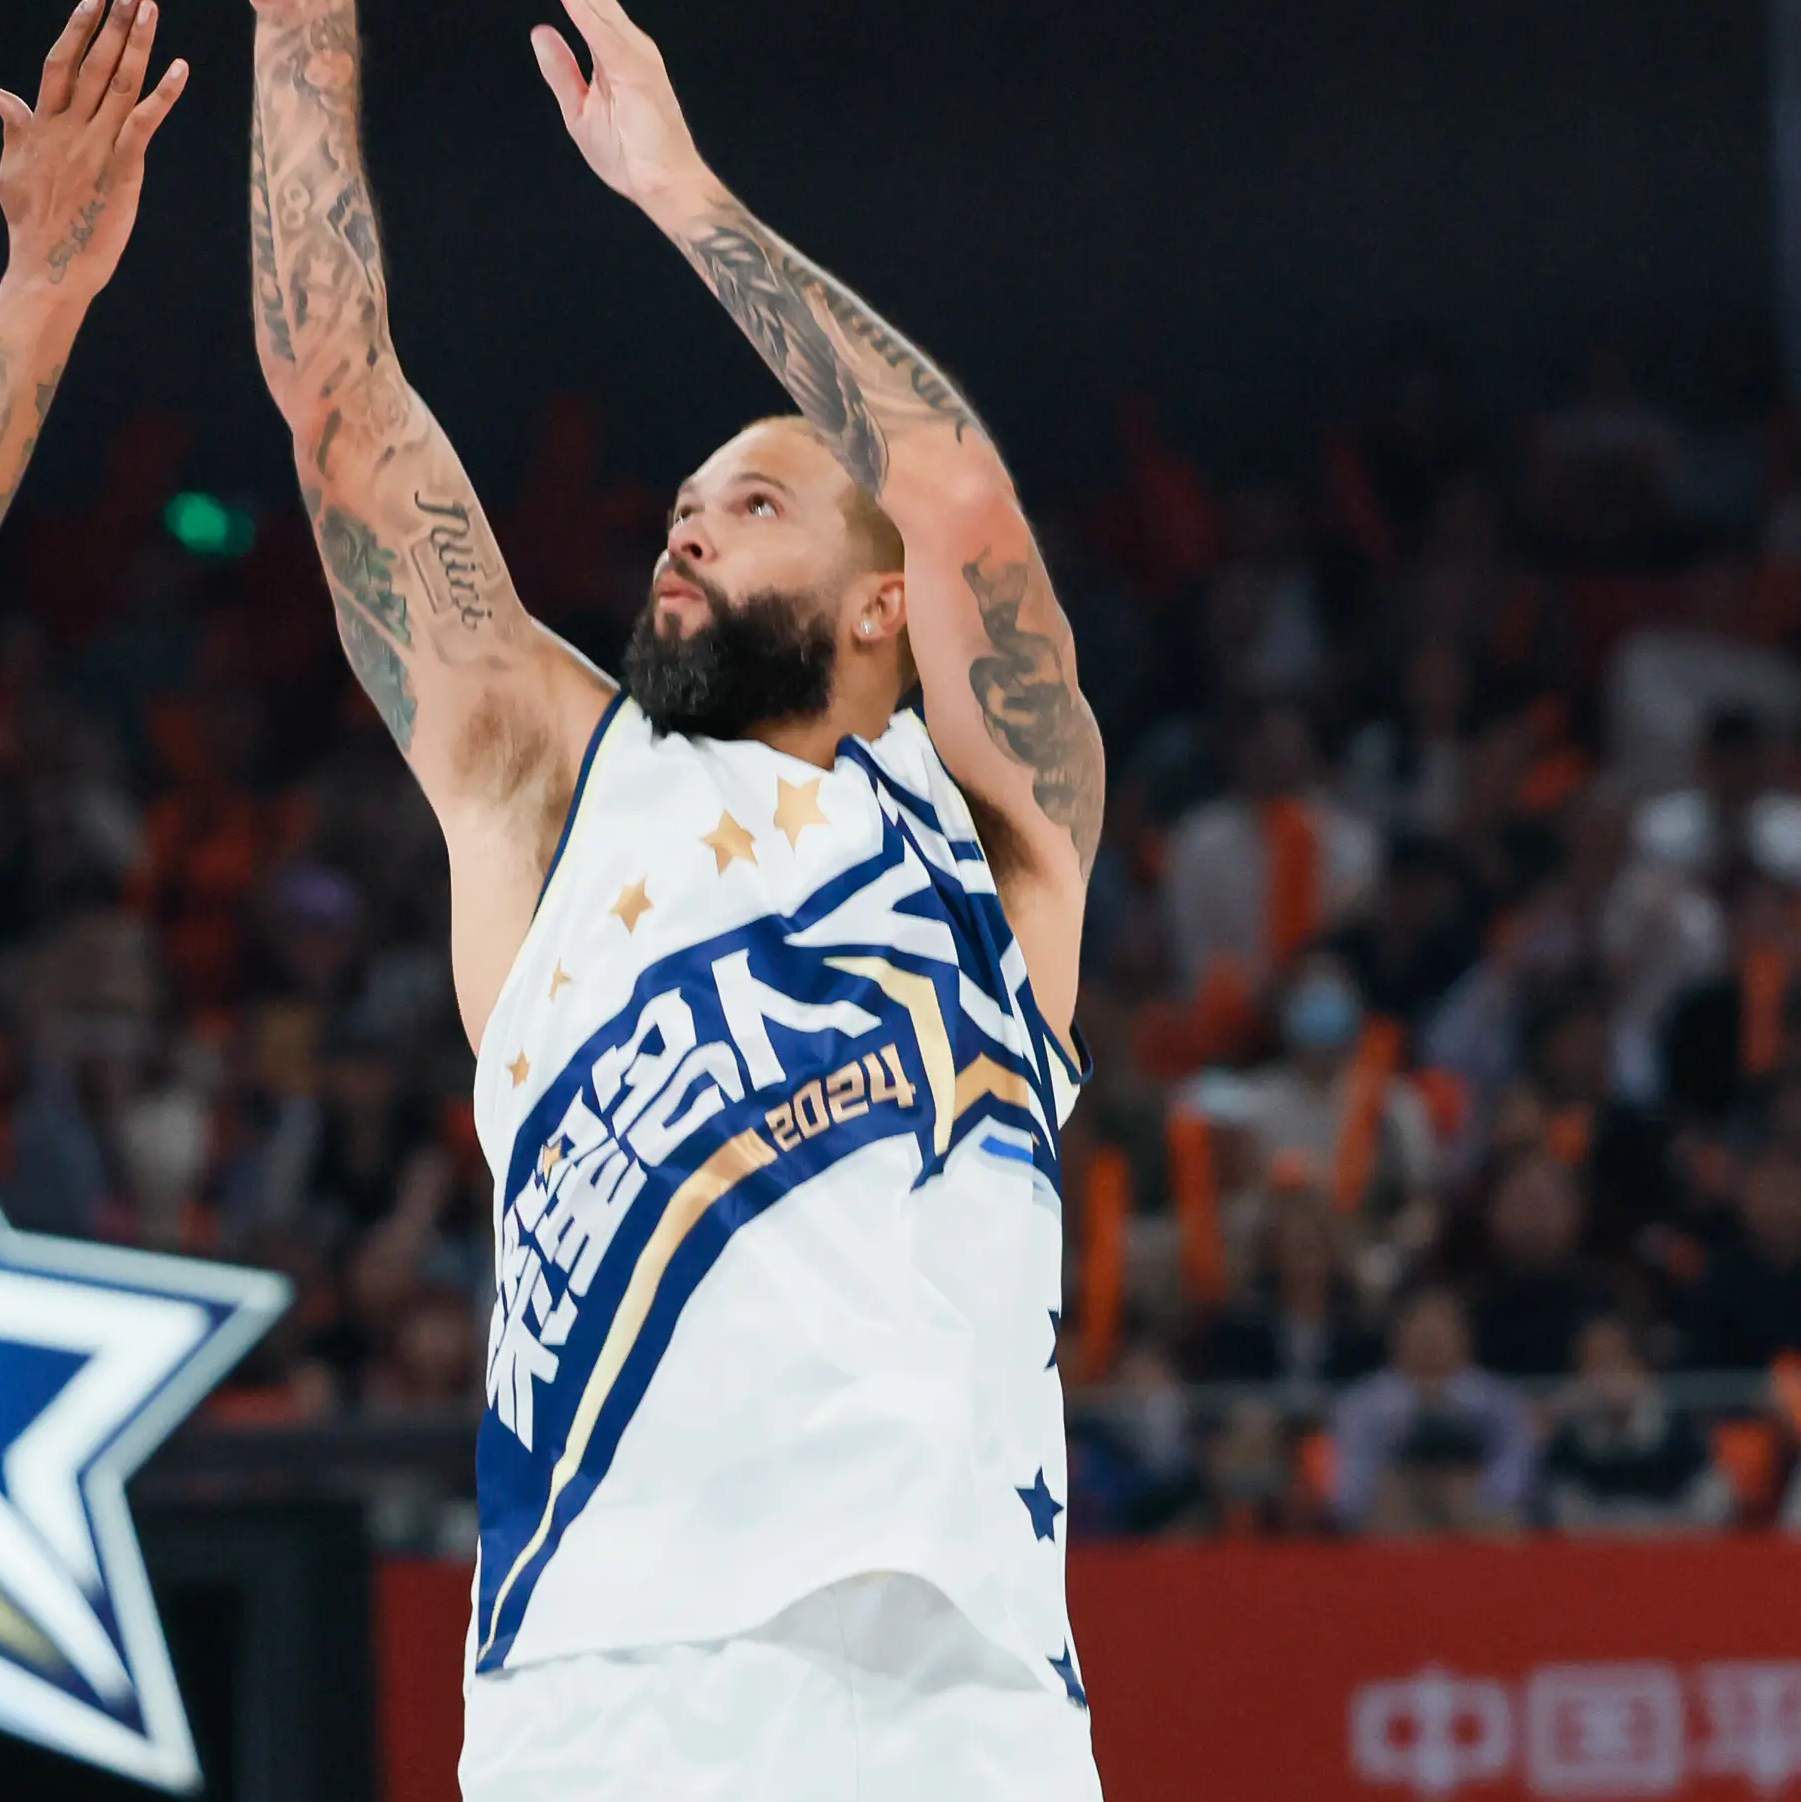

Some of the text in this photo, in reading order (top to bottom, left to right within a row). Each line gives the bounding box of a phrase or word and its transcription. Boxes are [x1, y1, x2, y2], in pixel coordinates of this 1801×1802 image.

[486, 947, 883, 1454] 聚星名人
[764, 1043, 918, 1152] 2024
